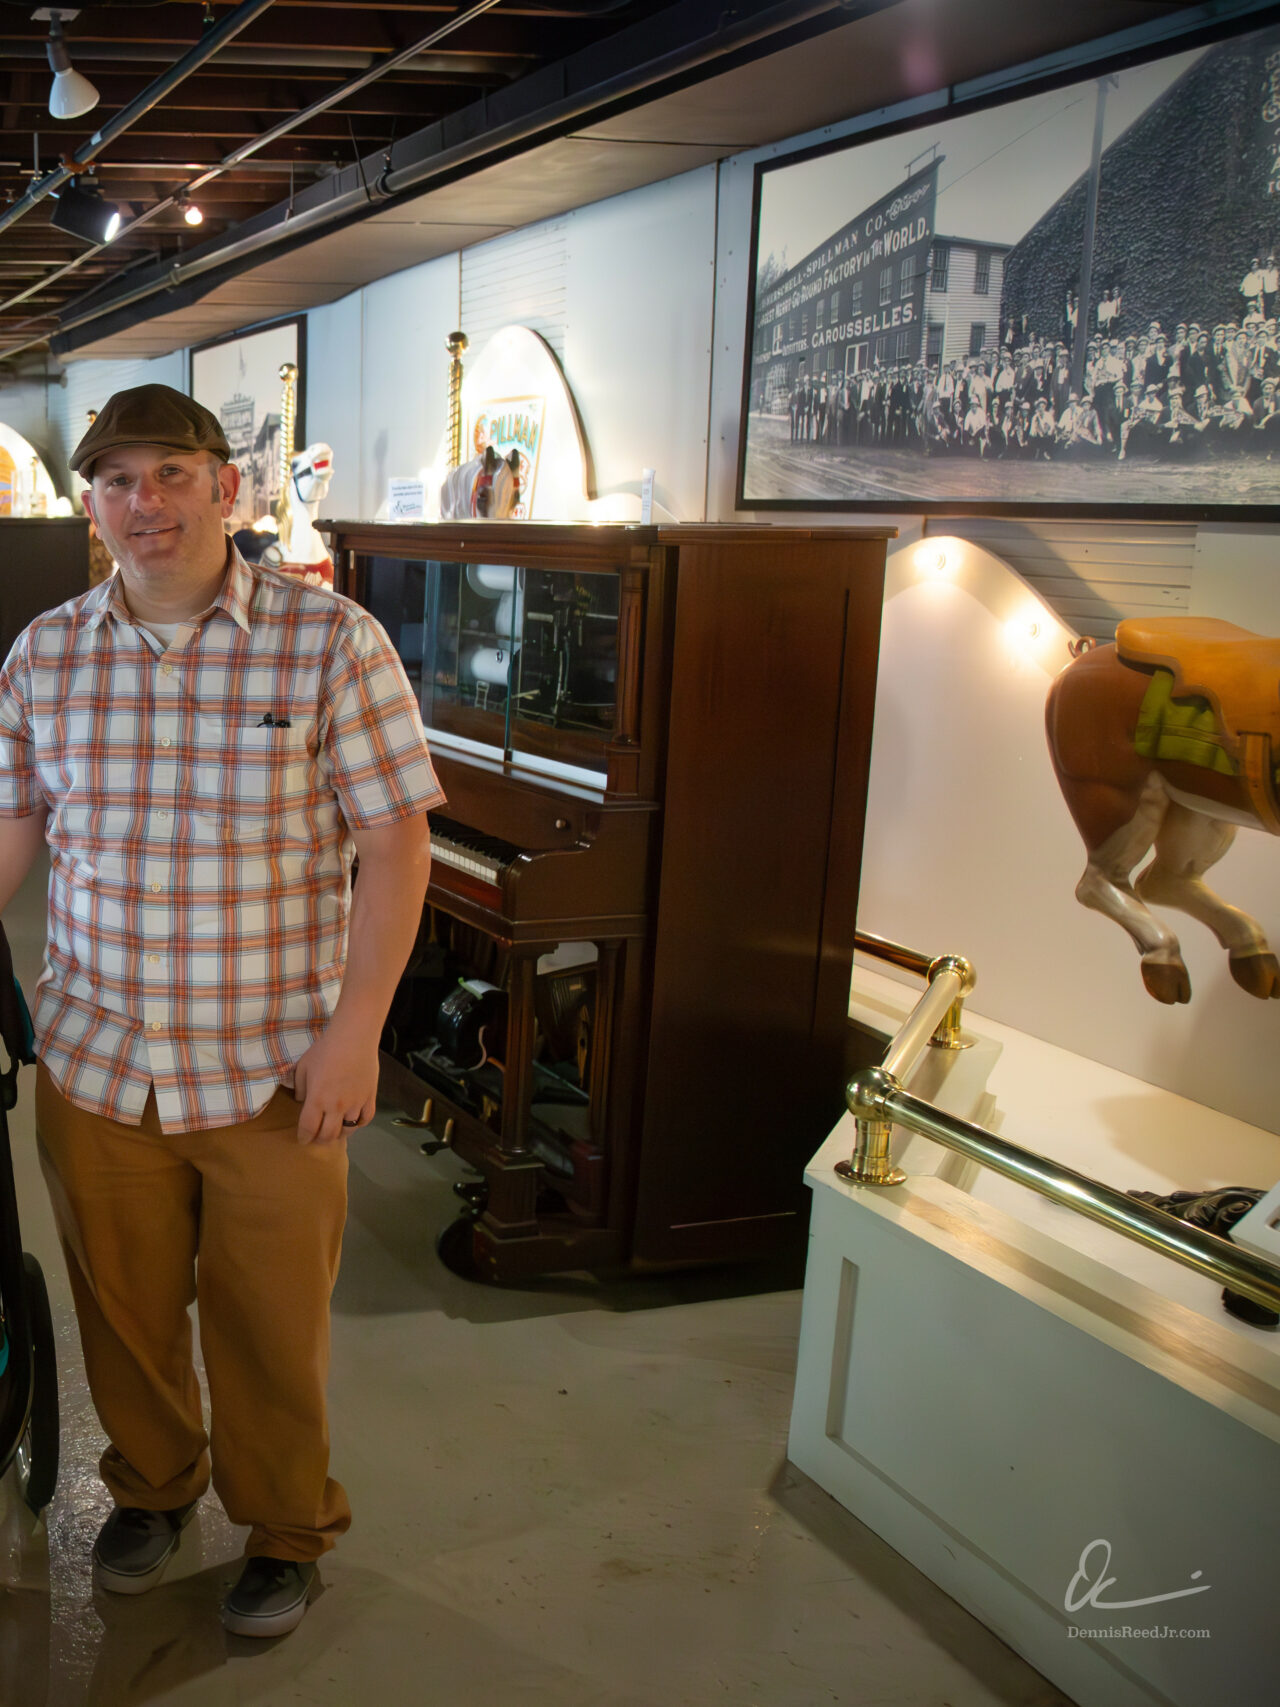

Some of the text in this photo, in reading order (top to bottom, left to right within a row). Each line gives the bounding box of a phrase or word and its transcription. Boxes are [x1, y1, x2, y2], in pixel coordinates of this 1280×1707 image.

[865, 214, 887, 237] CO.
[823, 251, 864, 291] FACTORY
[883, 217, 930, 258] WORLD.
[811, 303, 918, 348] CAROUSSELLES.
